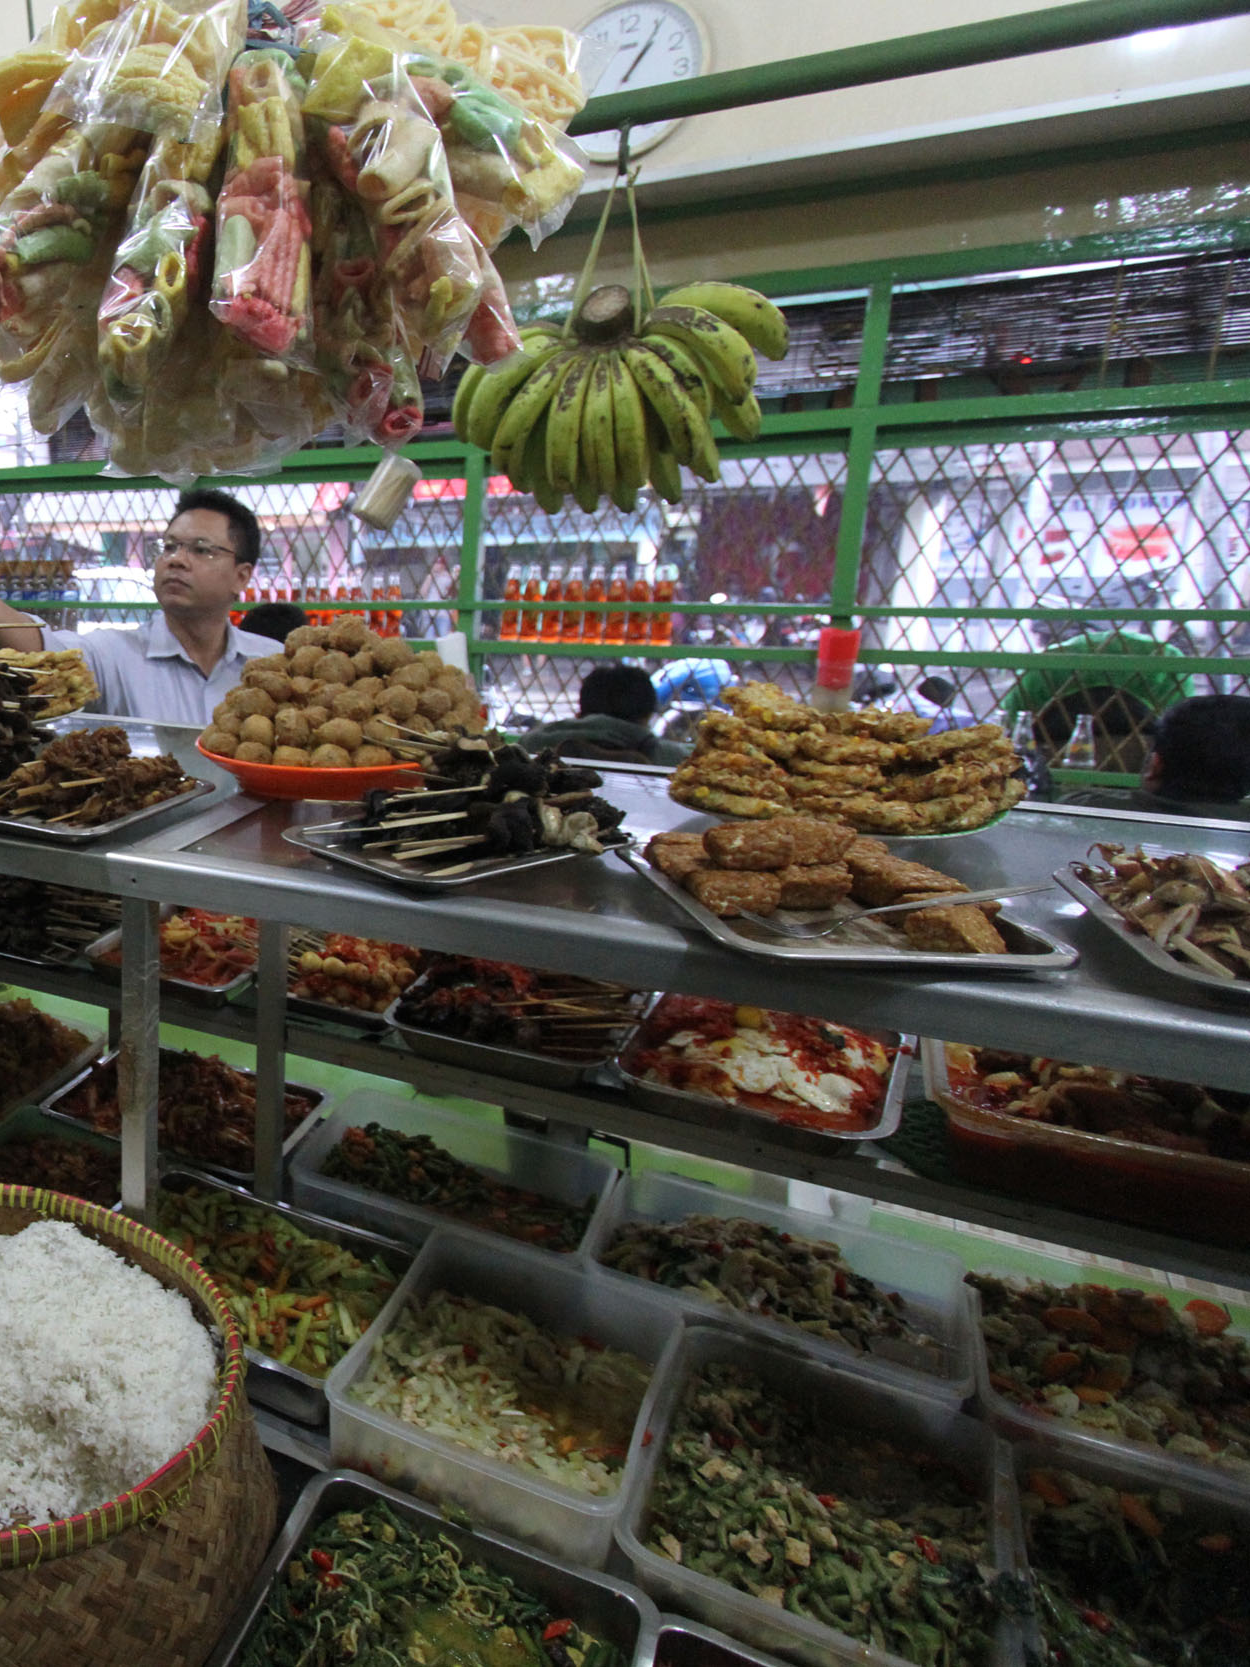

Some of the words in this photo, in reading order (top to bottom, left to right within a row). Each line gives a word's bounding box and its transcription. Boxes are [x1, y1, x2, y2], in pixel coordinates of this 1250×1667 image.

[620, 14, 640, 34] 12
[668, 31, 685, 51] 2
[673, 57, 690, 76] 3
